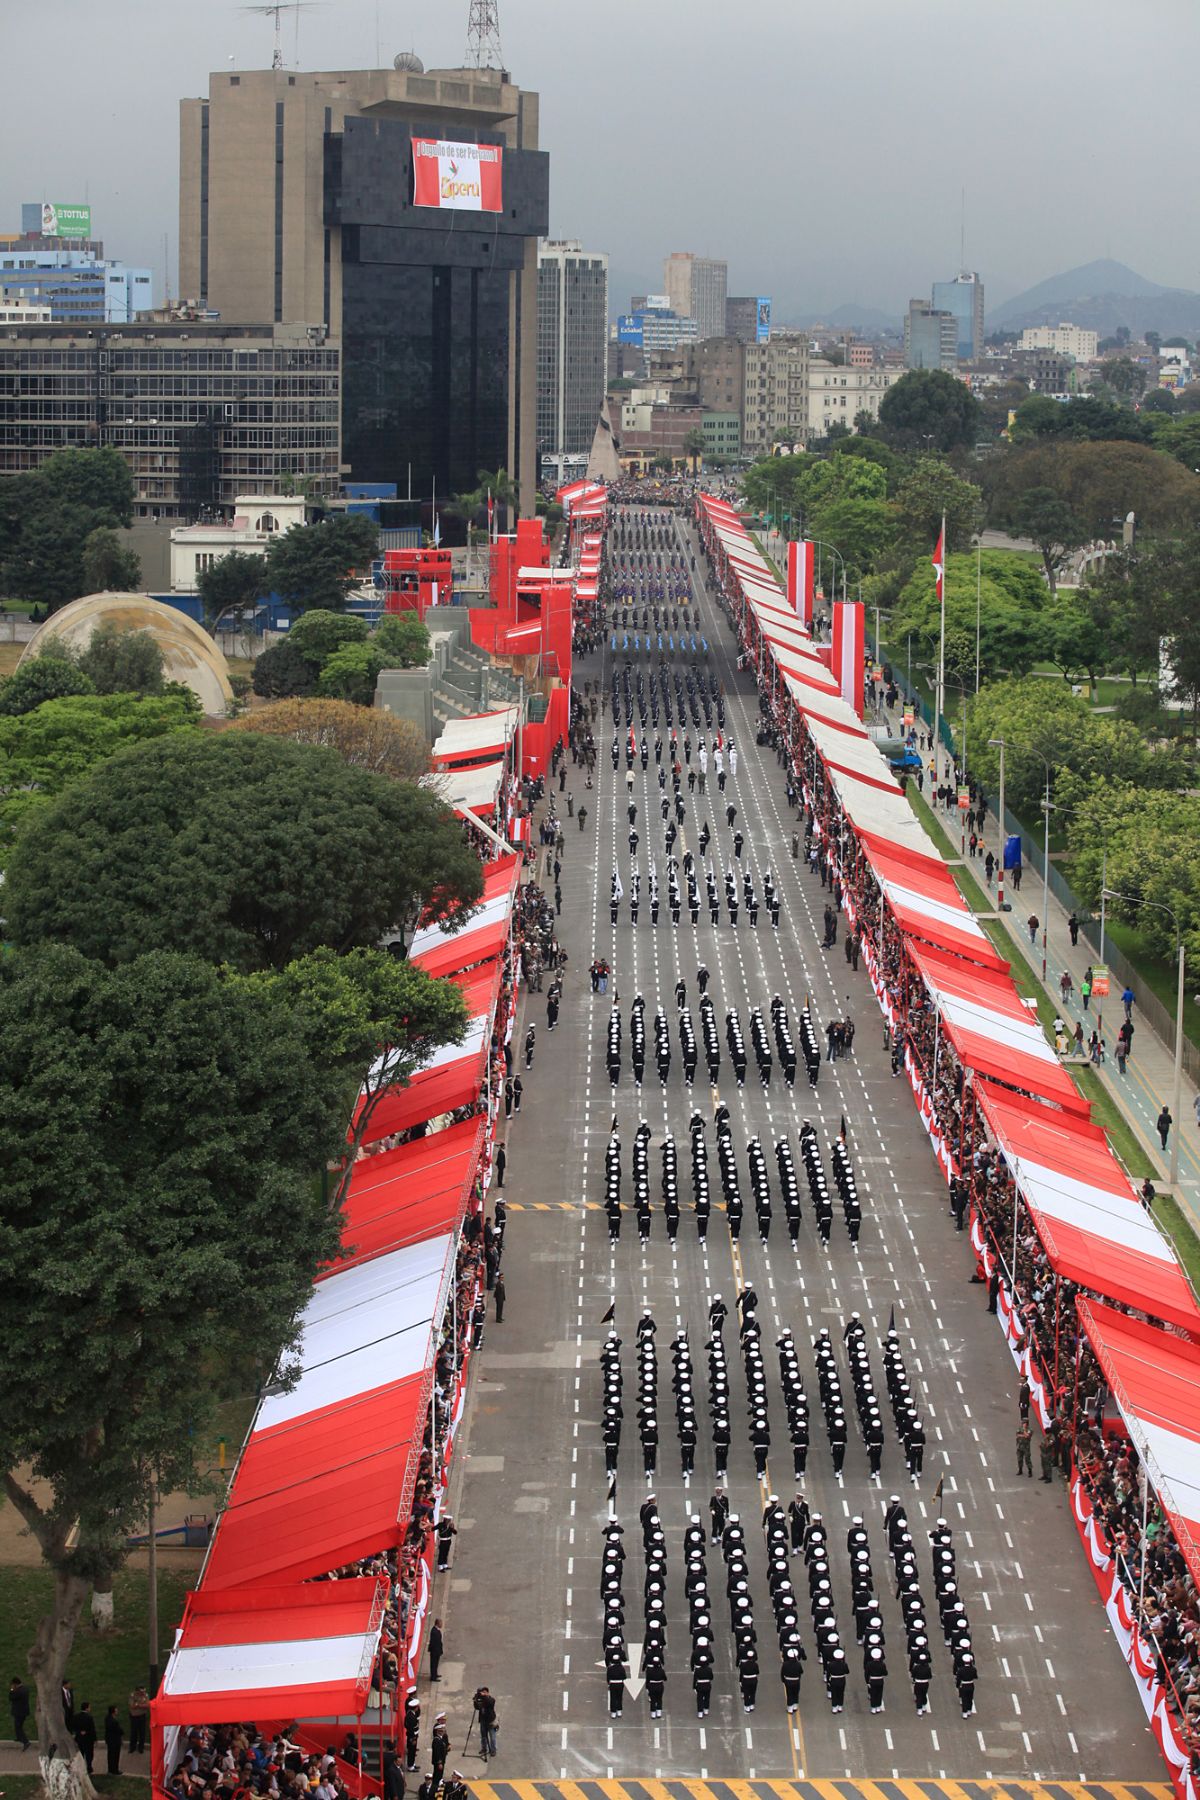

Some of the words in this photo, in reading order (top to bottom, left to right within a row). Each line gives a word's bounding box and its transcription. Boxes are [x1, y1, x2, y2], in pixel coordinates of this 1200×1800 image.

[446, 144, 455, 157] de
[456, 147, 467, 159] ser
[63, 210, 88, 219] TOTTUS
